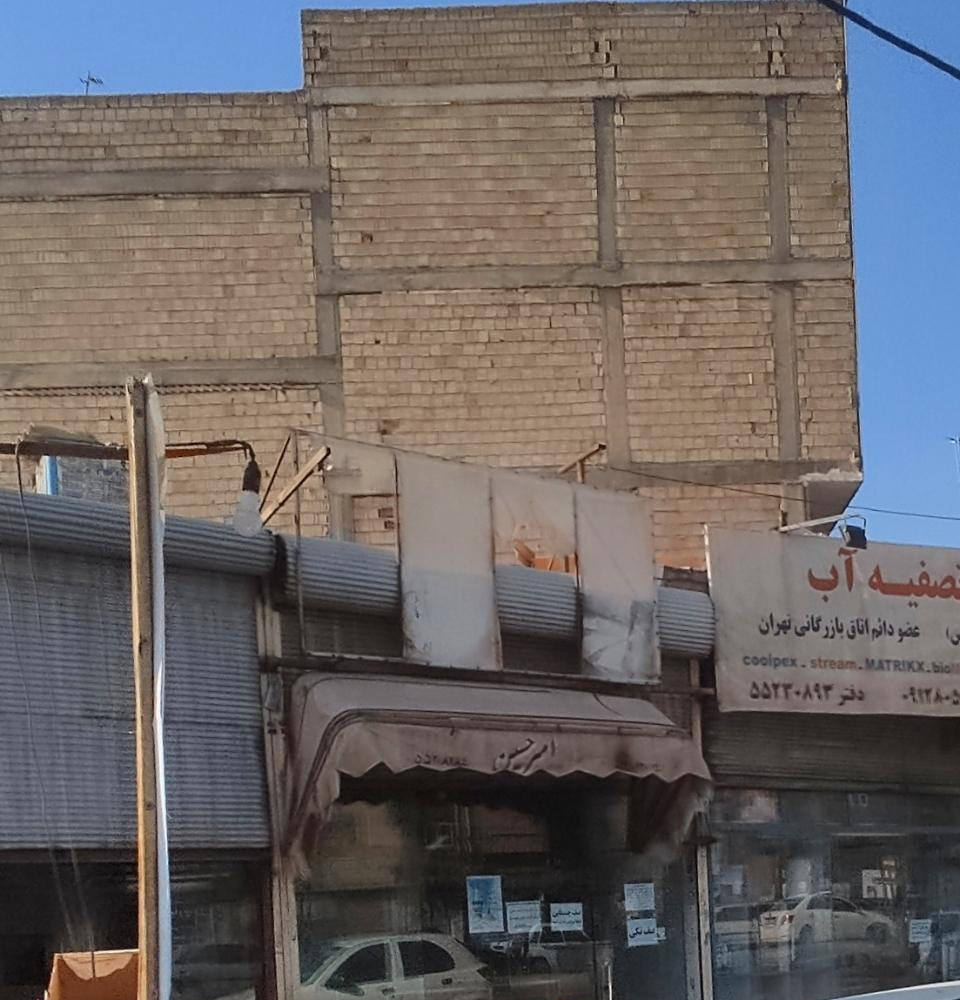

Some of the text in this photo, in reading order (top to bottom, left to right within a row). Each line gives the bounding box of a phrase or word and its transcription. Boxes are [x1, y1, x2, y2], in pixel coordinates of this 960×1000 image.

[808, 547, 858, 602] آب
[758, 611, 791, 636] تهران
[794, 614, 844, 639] بازرگانی
[898, 621, 920, 641] عضو
[838, 684, 865, 706] دفتر
